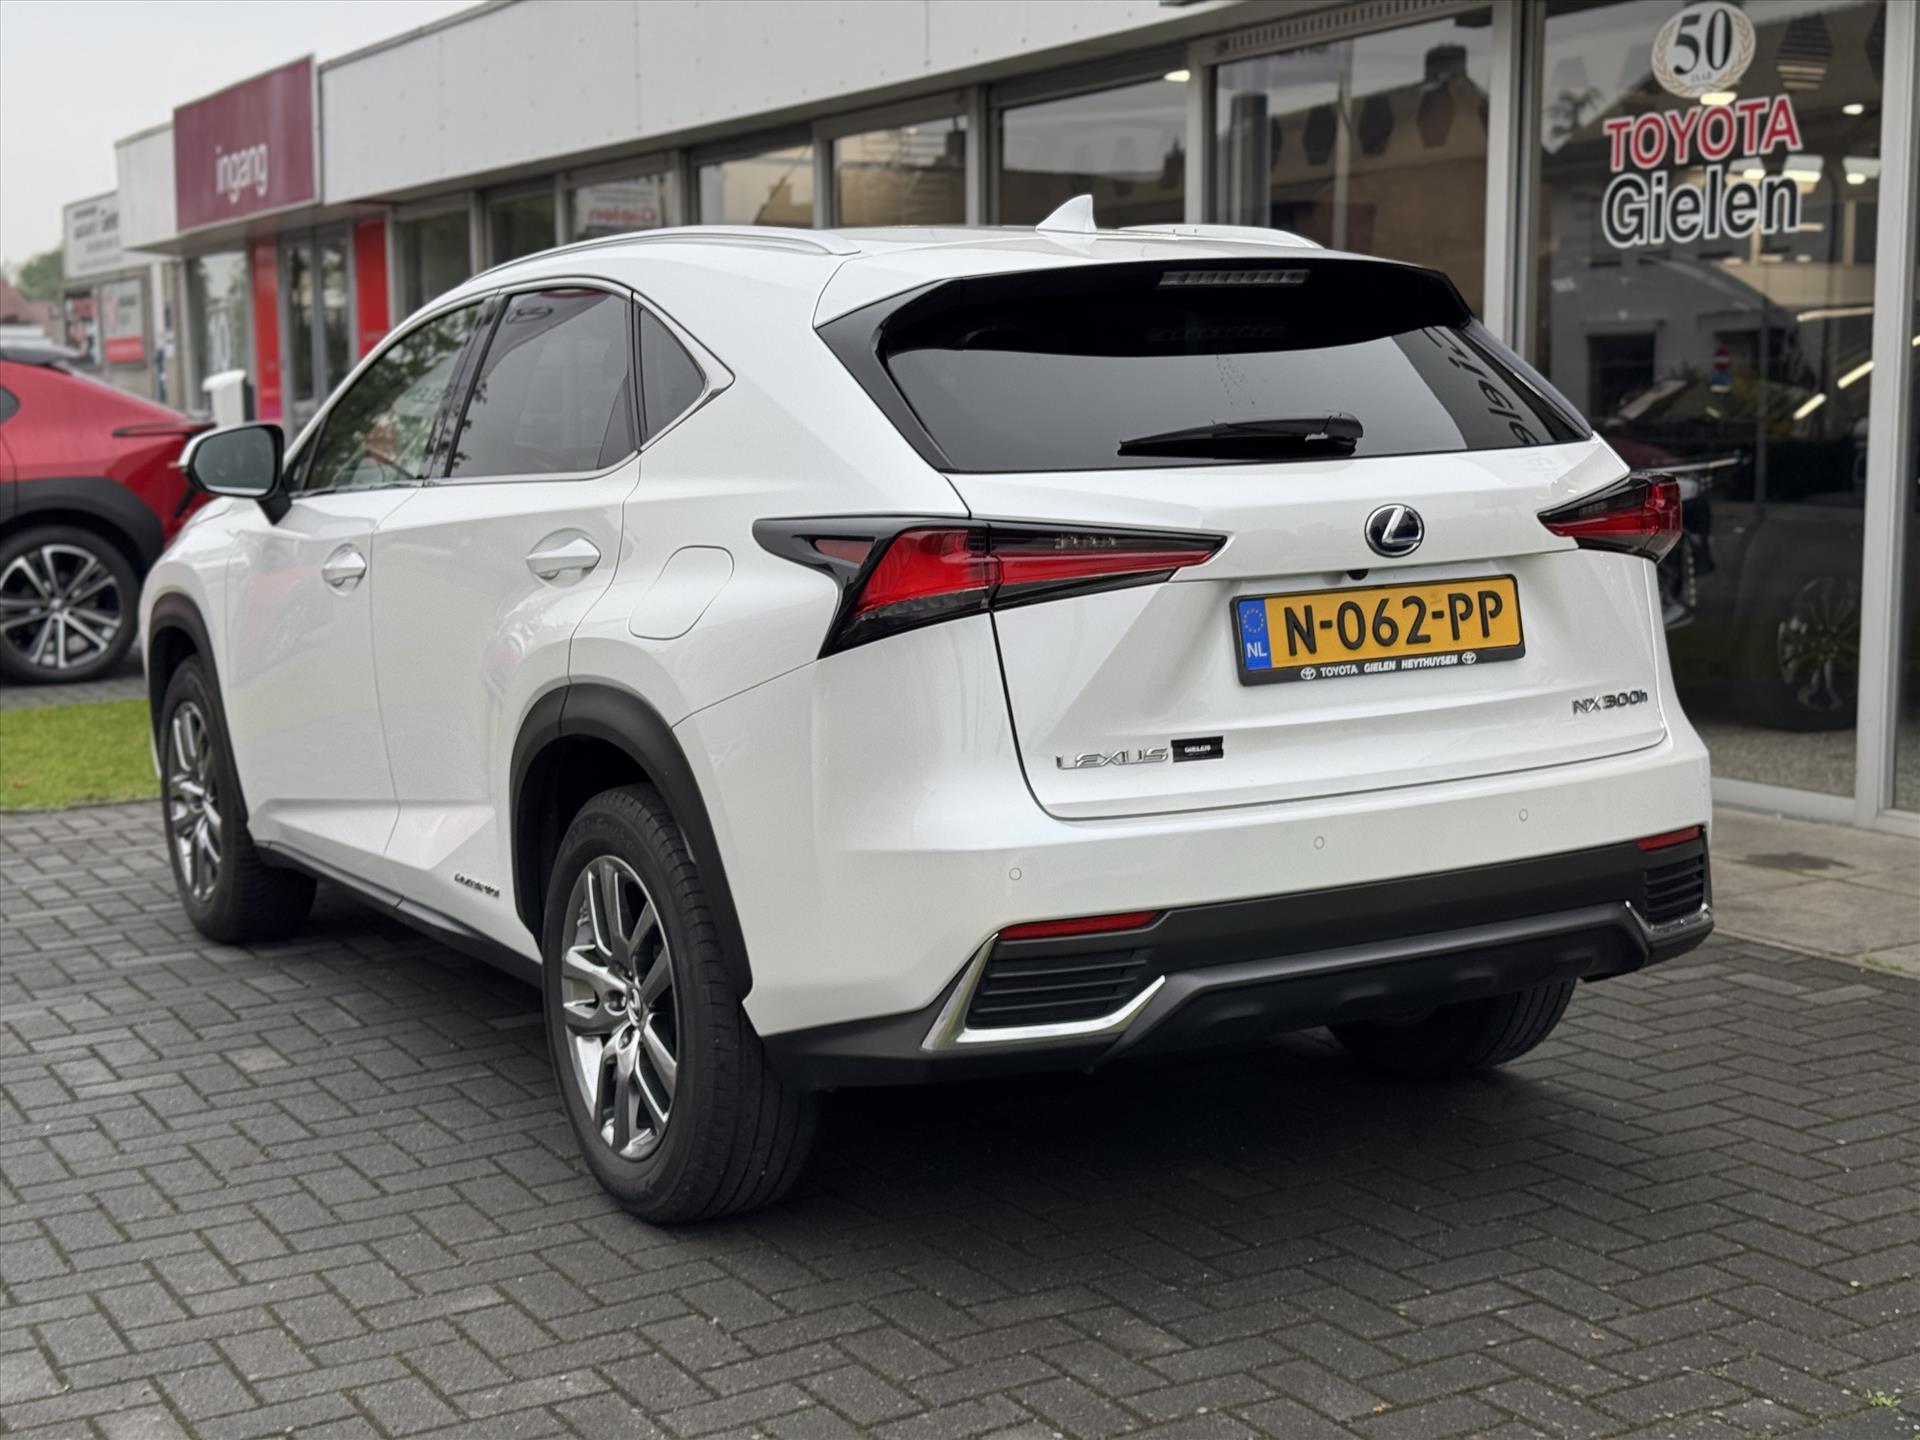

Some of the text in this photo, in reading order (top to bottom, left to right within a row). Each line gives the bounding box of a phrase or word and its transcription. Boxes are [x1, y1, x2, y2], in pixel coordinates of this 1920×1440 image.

[1672, 8, 1732, 75] 50
[1605, 96, 1801, 171] TOYOTA
[215, 144, 268, 203] ingang
[1603, 166, 1800, 247] Gielen
[1247, 642, 1268, 658] NL
[1284, 590, 1503, 656] N-062-PP
[1320, 654, 1458, 678] TOYOTA GIELEN HEYTHUYSEN
[1572, 689, 1648, 715] NX 300h
[1056, 748, 1169, 770] LEXUS
